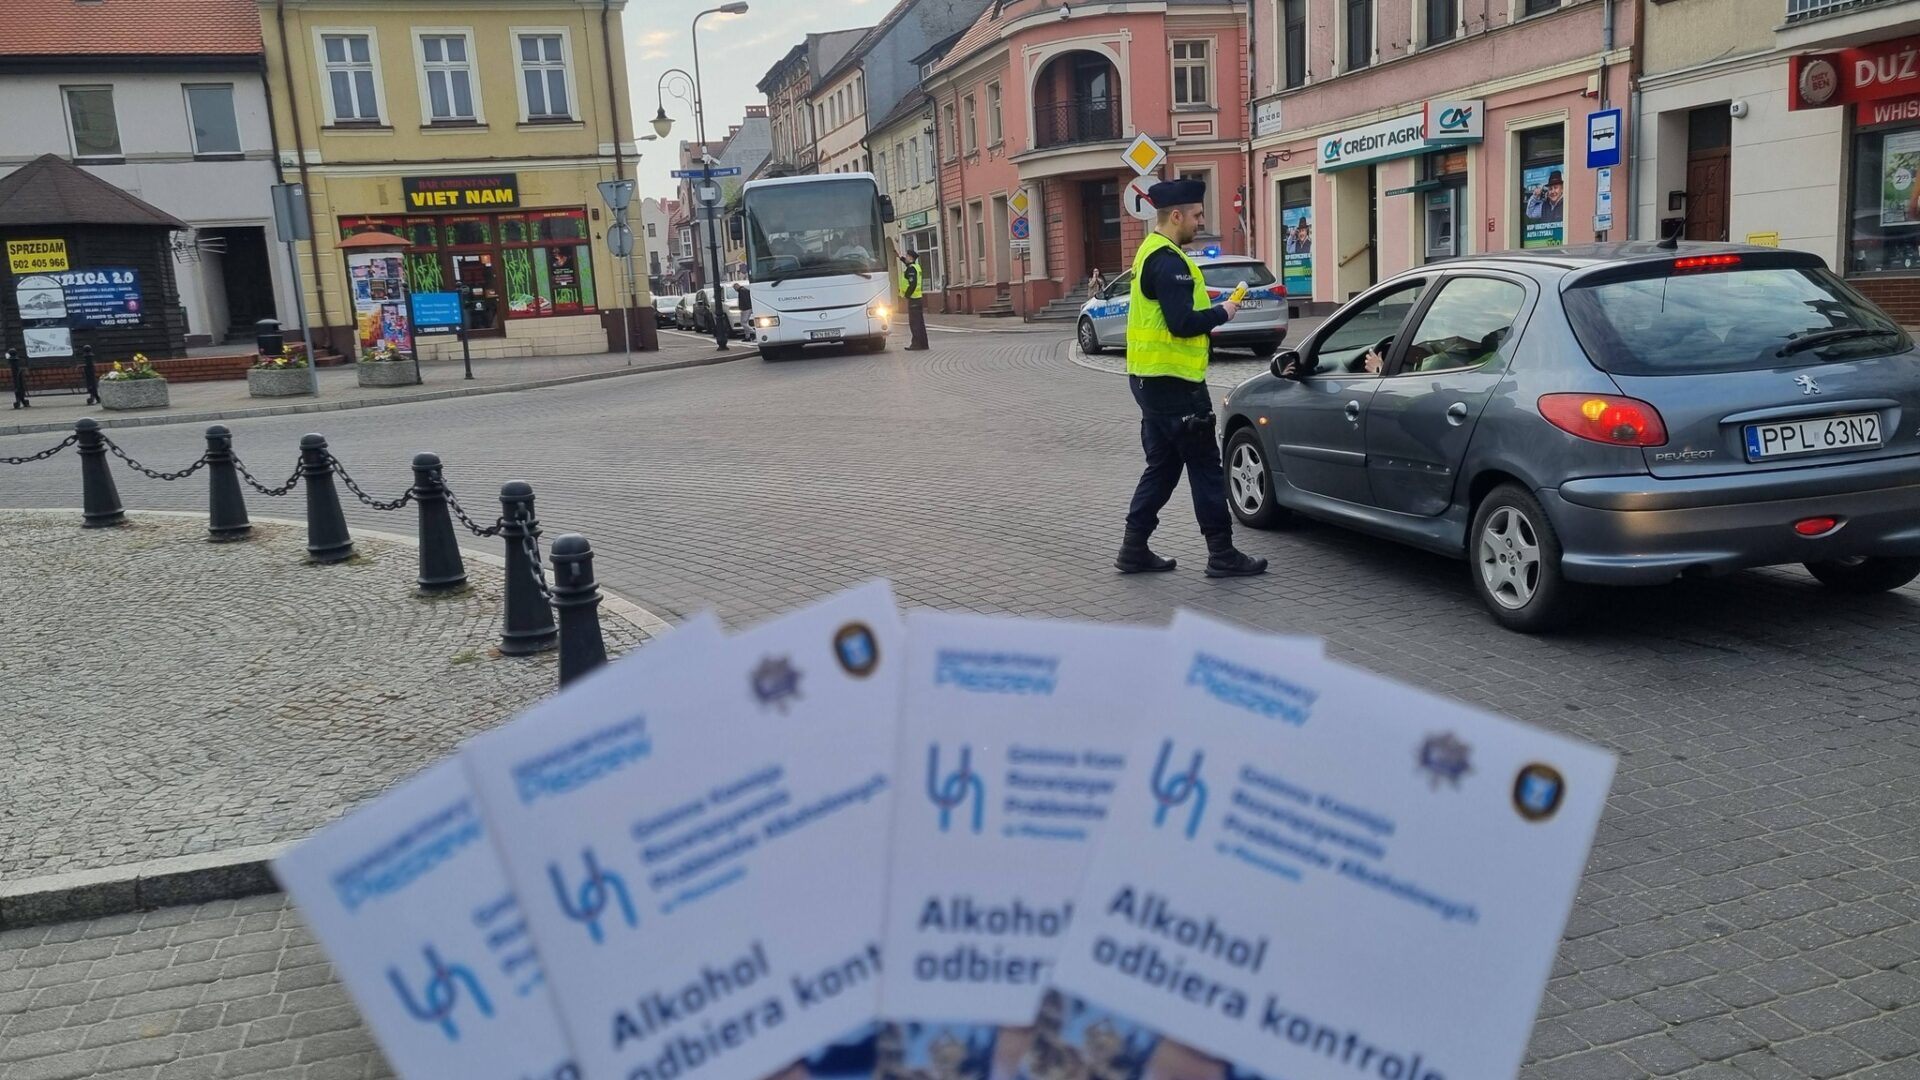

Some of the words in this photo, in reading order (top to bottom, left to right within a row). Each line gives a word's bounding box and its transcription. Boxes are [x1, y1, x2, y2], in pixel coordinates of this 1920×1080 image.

[1855, 45, 1920, 89] DUŻ
[1812, 80, 1830, 91] BEN
[1874, 100, 1920, 123] WHIS
[1344, 133, 1386, 155] CRÉDIT
[411, 190, 459, 206] VIET
[465, 188, 513, 204] NAM
[10, 242, 65, 255] SPRZEDAM
[13, 260, 29, 269] 602
[32, 259, 47, 268] 405
[49, 258, 65, 267] 966
[112, 272, 134, 284] 2.0
[1763, 425, 1815, 454] PPL
[1824, 417, 1878, 446] 63N2
[1655, 449, 1716, 462] PEUGEOT
[1108, 884, 1269, 973] Alkohol
[915, 945, 1052, 984] odbier
[1092, 935, 1248, 1021] odbiera
[611, 940, 770, 1049] Alkohol
[626, 998, 786, 1080] odbiera
